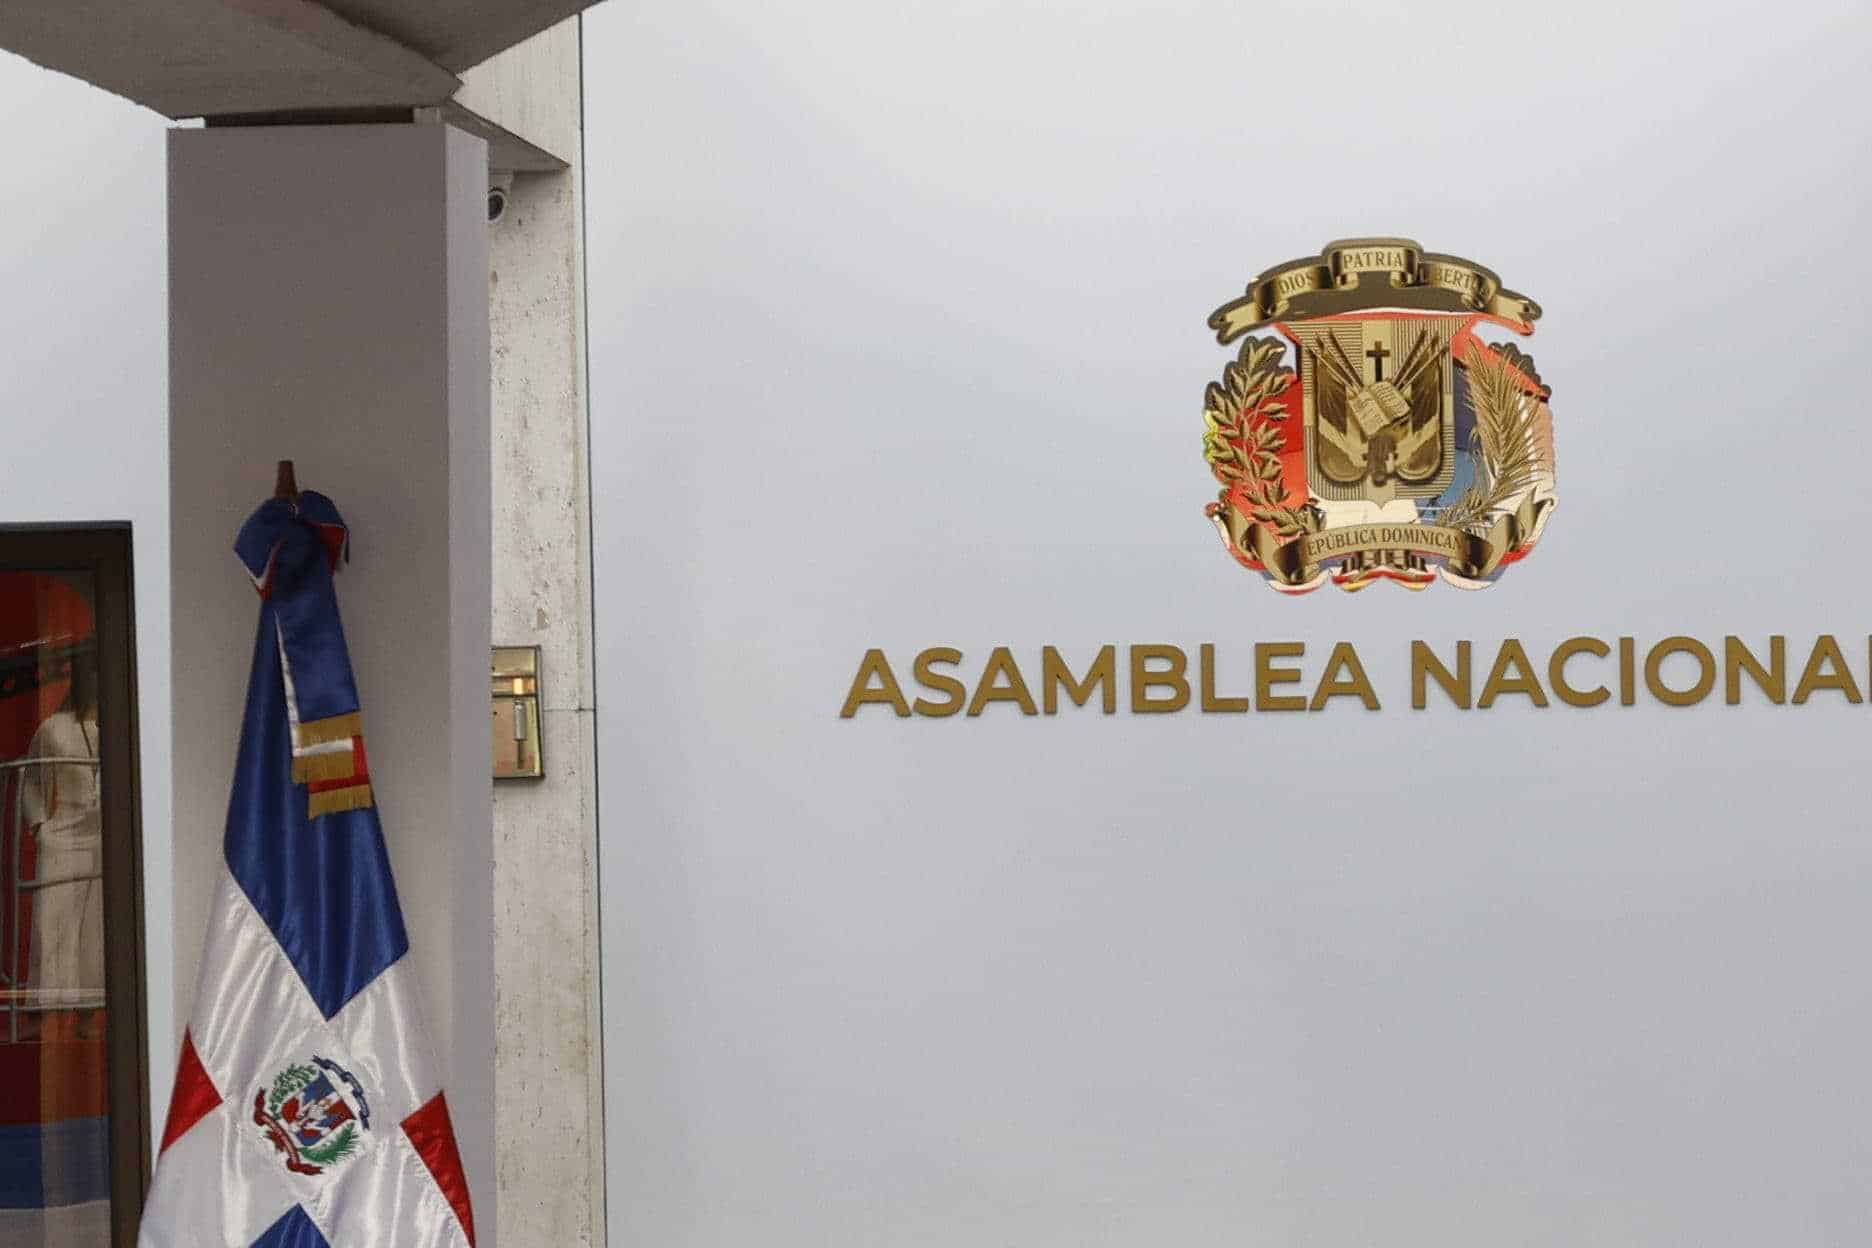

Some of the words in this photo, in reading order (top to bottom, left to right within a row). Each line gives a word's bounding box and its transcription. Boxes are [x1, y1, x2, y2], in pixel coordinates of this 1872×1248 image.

[1343, 250, 1406, 269] PATRIA
[1308, 527, 1377, 555] EPÚBLICA
[841, 640, 1378, 719] ASAMBLEA
